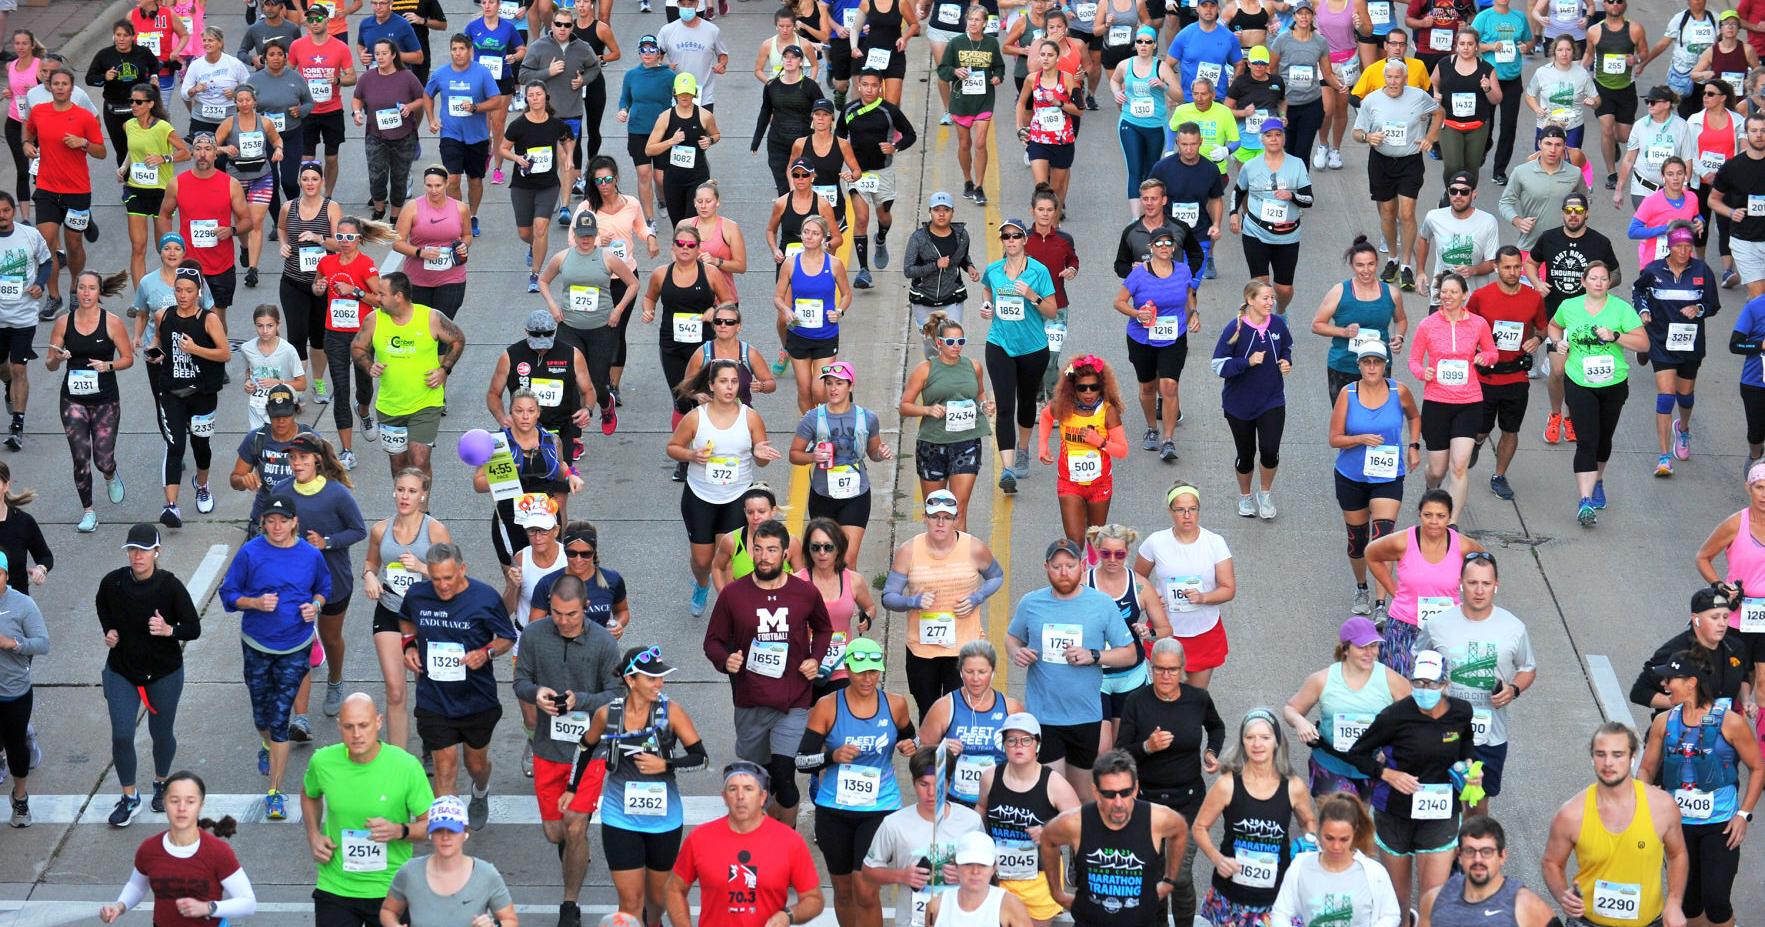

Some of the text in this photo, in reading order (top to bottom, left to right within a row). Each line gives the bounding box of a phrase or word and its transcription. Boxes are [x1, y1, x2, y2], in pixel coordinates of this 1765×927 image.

[1436, 36, 1448, 44] 1171
[964, 79, 983, 87] 2540
[1456, 101, 1472, 109] 1432
[381, 116, 398, 124] 1695
[1385, 129, 1404, 138] 2321
[673, 154, 692, 162] 1082
[1652, 151, 1671, 159] 1844
[135, 172, 155, 180] 1540
[860, 180, 874, 188] 333
[1176, 211, 1196, 220] 2270
[1266, 208, 1283, 217] 1213
[1553, 250, 1588, 267] LOST ROADS
[1, 286, 18, 295] 885
[576, 297, 592, 306] 275
[333, 310, 355, 318] 2062
[802, 309, 815, 318] 181
[1000, 306, 1020, 315] 1852
[679, 324, 697, 332] 542
[1154, 326, 1173, 335] 1216
[1497, 331, 1518, 341] 2417
[1671, 333, 1692, 342] 3251
[173, 363, 189, 371] ALL
[1587, 366, 1611, 375] 3333
[1442, 370, 1464, 379] 1999
[73, 381, 93, 390] 2131
[538, 391, 555, 400] 491
[949, 411, 974, 421] 2434
[1075, 461, 1095, 471] 500
[1370, 456, 1394, 467] 1649
[264, 464, 279, 474] BUT
[488, 462, 512, 475] 4:55
[712, 469, 731, 480] 372
[838, 477, 850, 487] 67
[393, 576, 414, 586] 250
[420, 610, 448, 618] run with
[420, 619, 470, 630] ENDURANCE
[757, 608, 789, 632] M
[927, 626, 946, 637] 277
[432, 656, 460, 667] 1329
[753, 652, 781, 665] 1655
[555, 722, 584, 736] 5072
[956, 726, 994, 736] FLEET
[845, 736, 876, 744] FLEET
[959, 736, 990, 745] FEET
[844, 779, 873, 792] 1359
[629, 798, 662, 808] 2362
[1418, 800, 1447, 810] 2140
[1677, 799, 1710, 810] 2408
[349, 845, 380, 858] 2514
[999, 855, 1034, 866] 2045
[1240, 865, 1270, 879] 1620
[1088, 875, 1142, 885] MARATHON
[1089, 884, 1141, 896] TRAINING
[728, 891, 756, 903] 70.3
[1598, 898, 1634, 911] 2290
